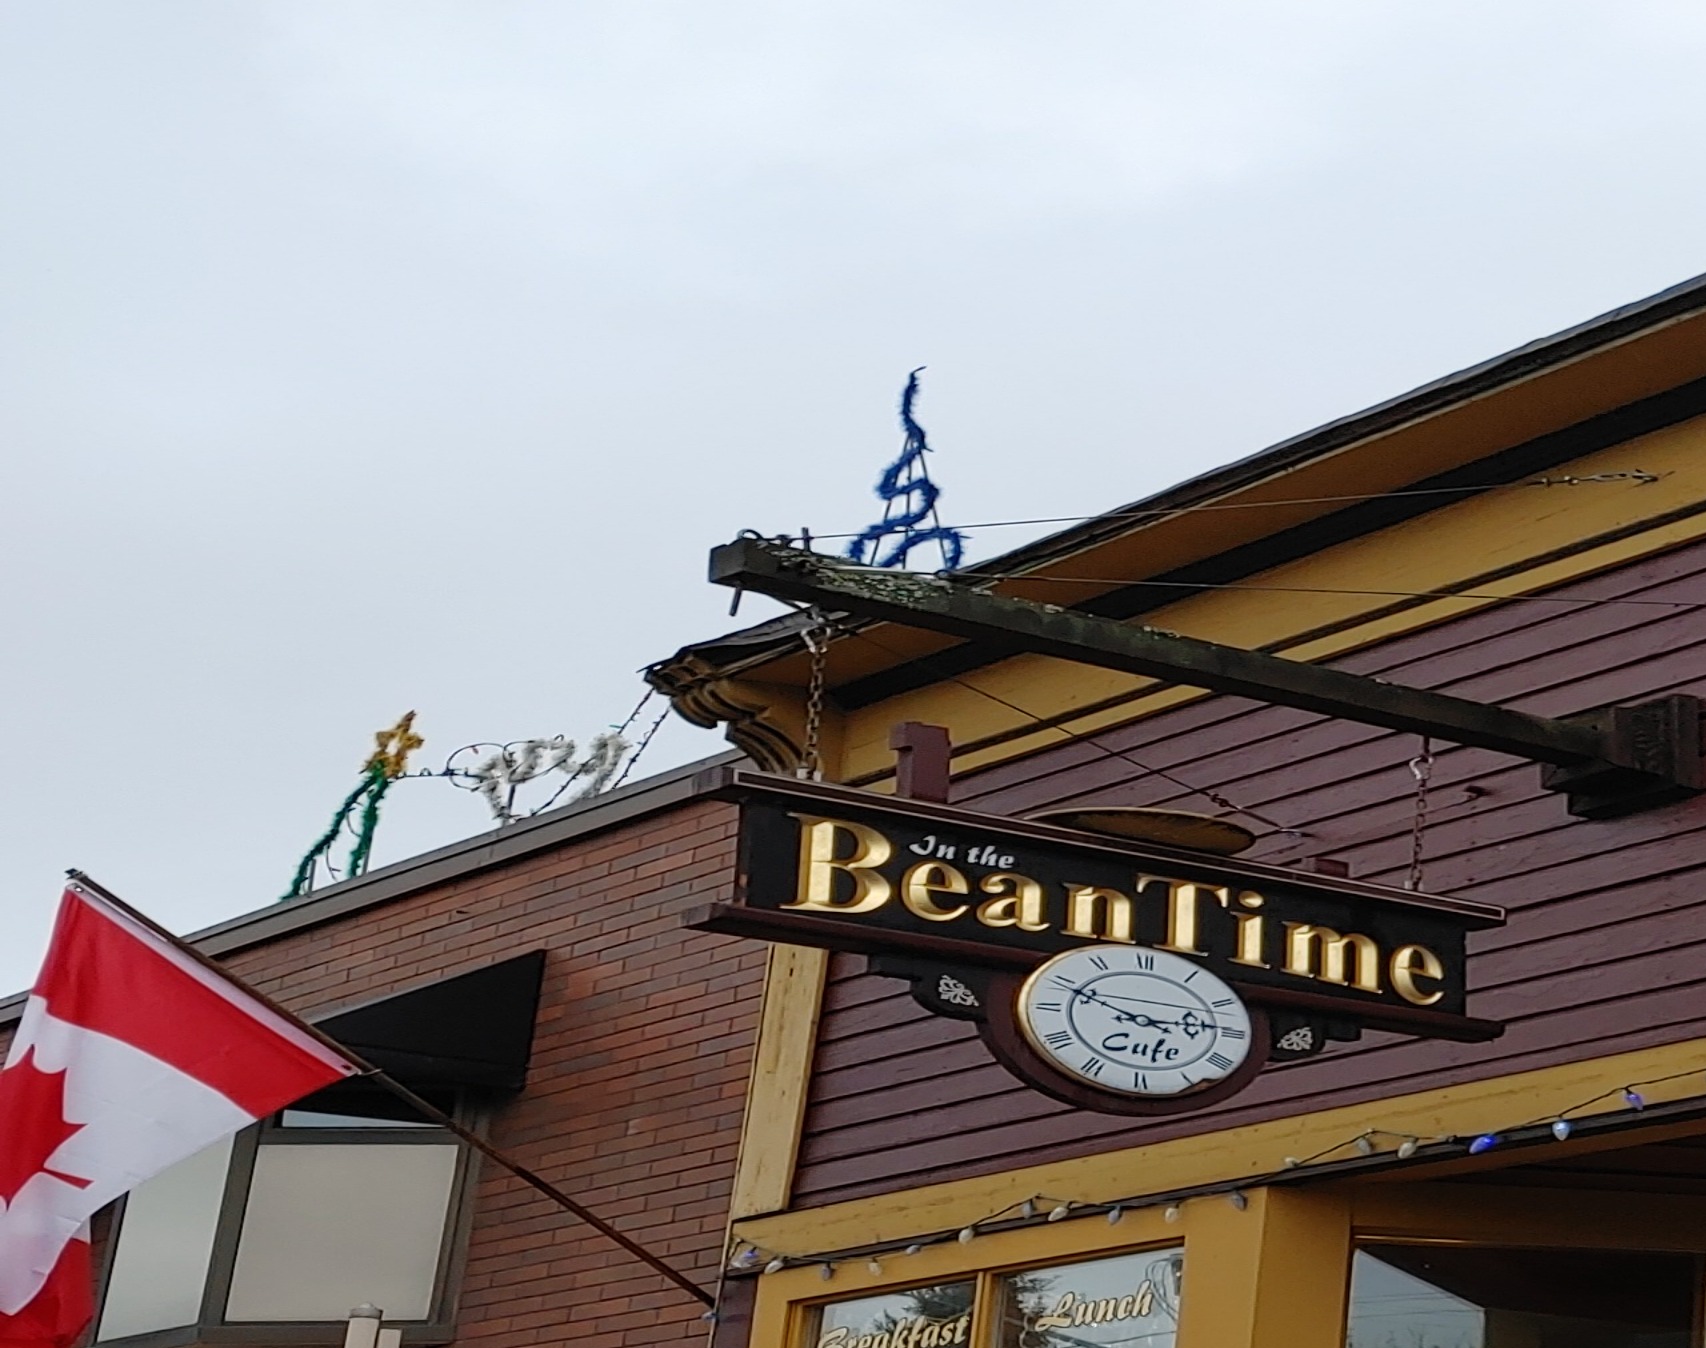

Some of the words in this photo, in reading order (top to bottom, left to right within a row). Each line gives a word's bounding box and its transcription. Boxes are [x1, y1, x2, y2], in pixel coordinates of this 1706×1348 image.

[908, 834, 957, 862] In
[966, 842, 1016, 870] the
[780, 811, 1446, 1006] BeanTime
[1034, 1280, 1153, 1331] Lunch
